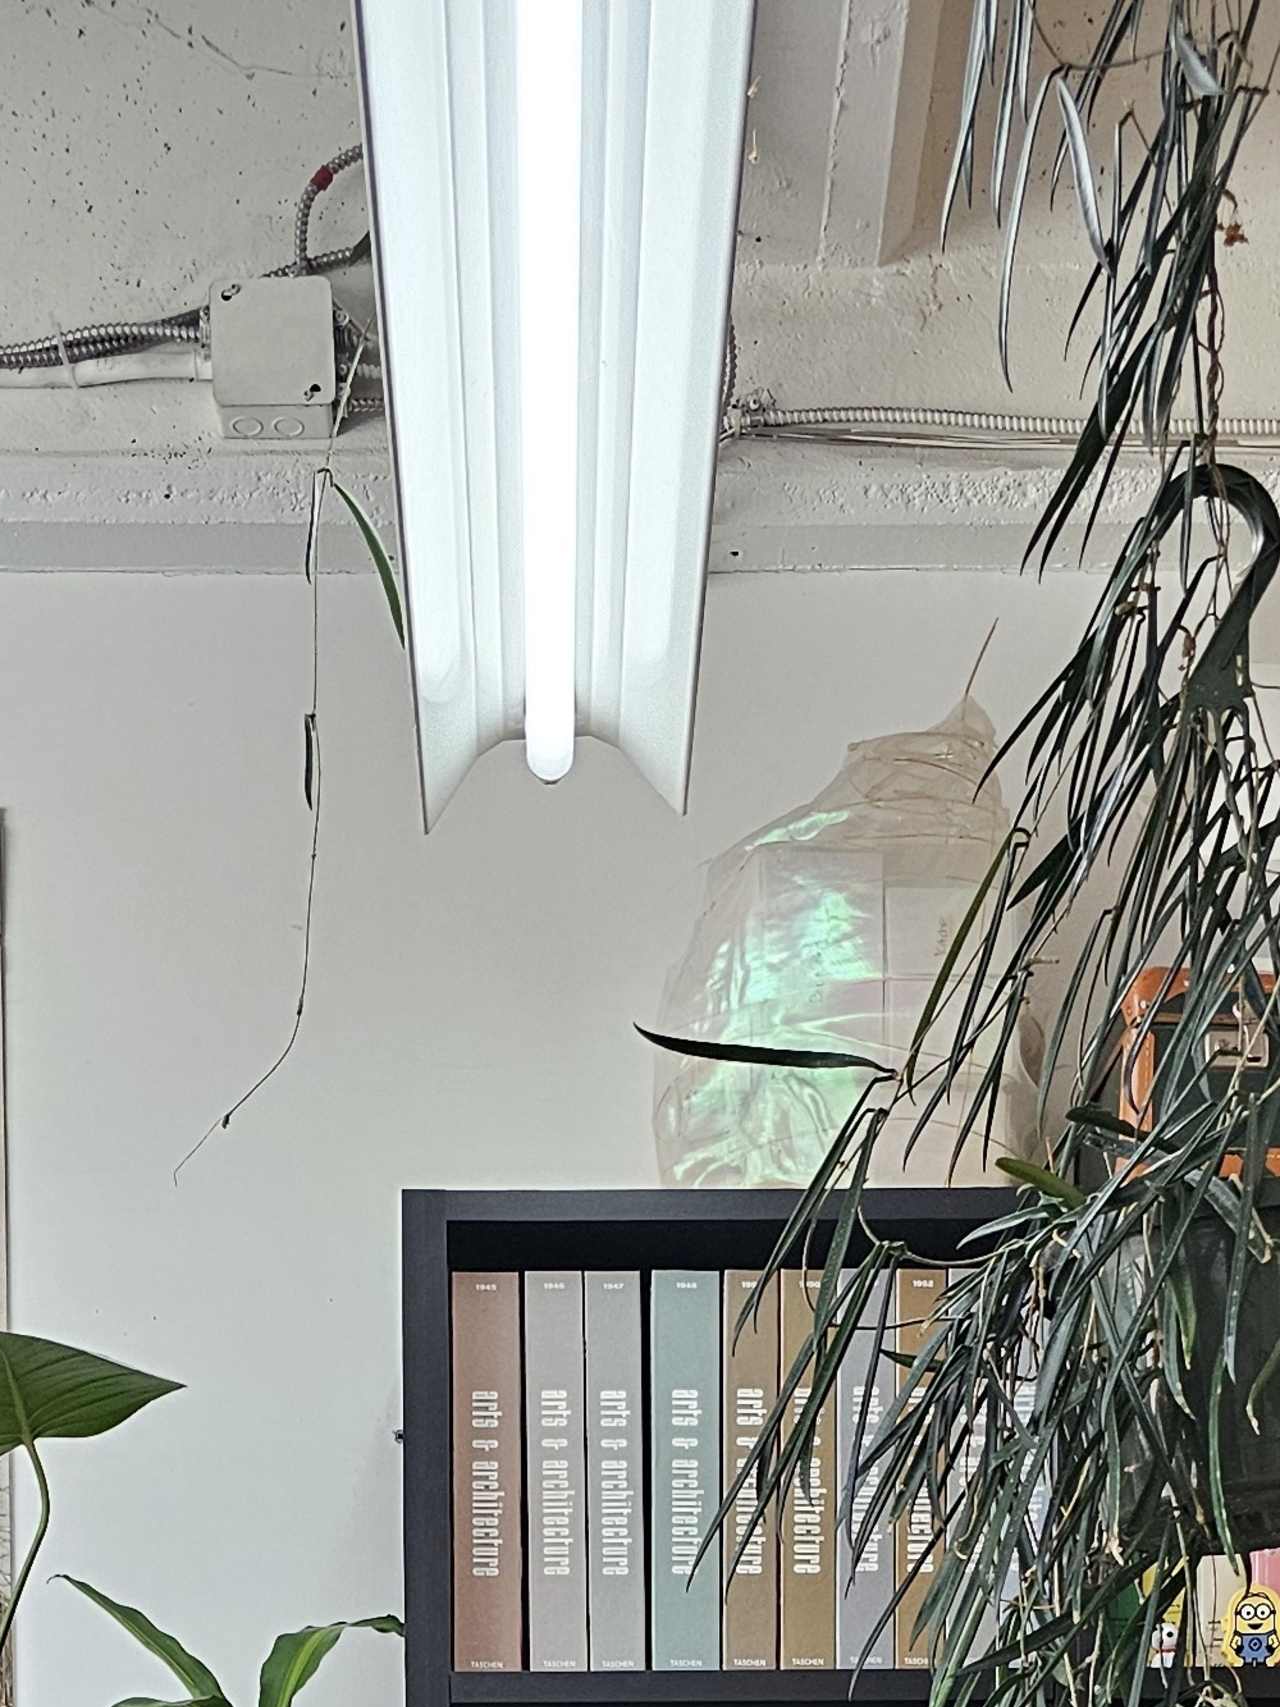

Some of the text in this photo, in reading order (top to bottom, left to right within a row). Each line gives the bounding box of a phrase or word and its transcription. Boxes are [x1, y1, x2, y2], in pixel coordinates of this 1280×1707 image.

[472, 1391, 502, 1576] arts architecture
[542, 1460, 575, 1575] architecture
[601, 1460, 632, 1575] architecture
